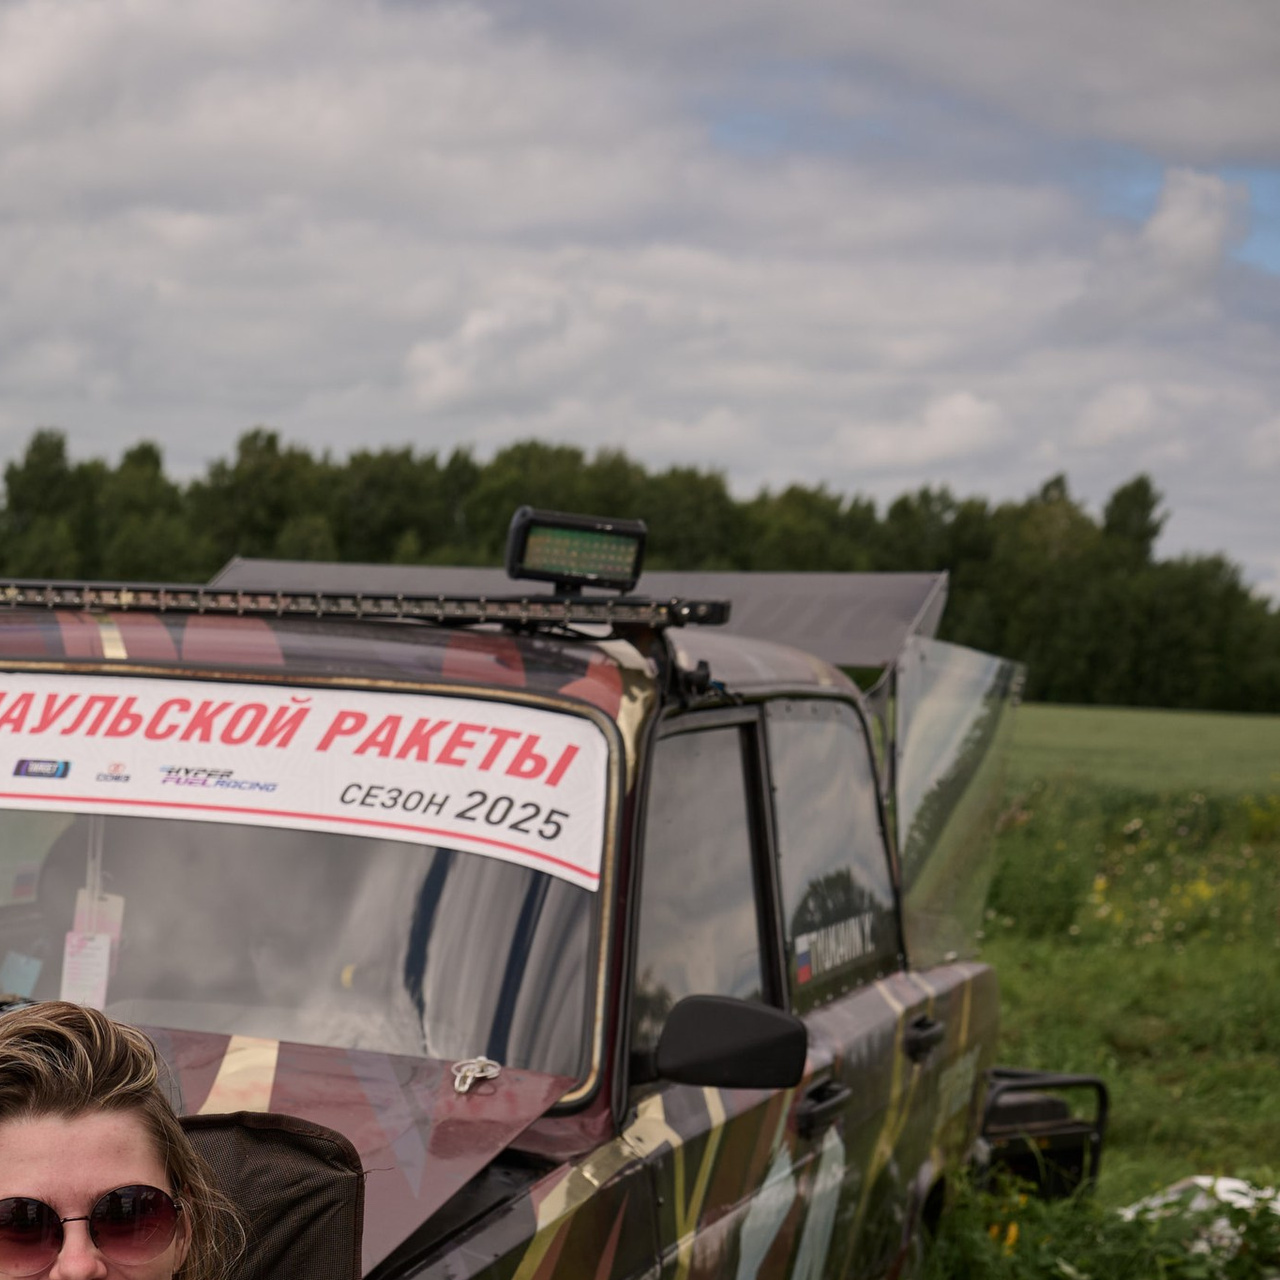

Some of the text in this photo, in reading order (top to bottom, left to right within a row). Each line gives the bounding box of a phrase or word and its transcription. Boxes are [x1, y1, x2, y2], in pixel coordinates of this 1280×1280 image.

[168, 766, 234, 779] HYPER
[317, 710, 579, 787] РАКЕТЫ
[340, 783, 570, 841] СЕЗОН 2025
